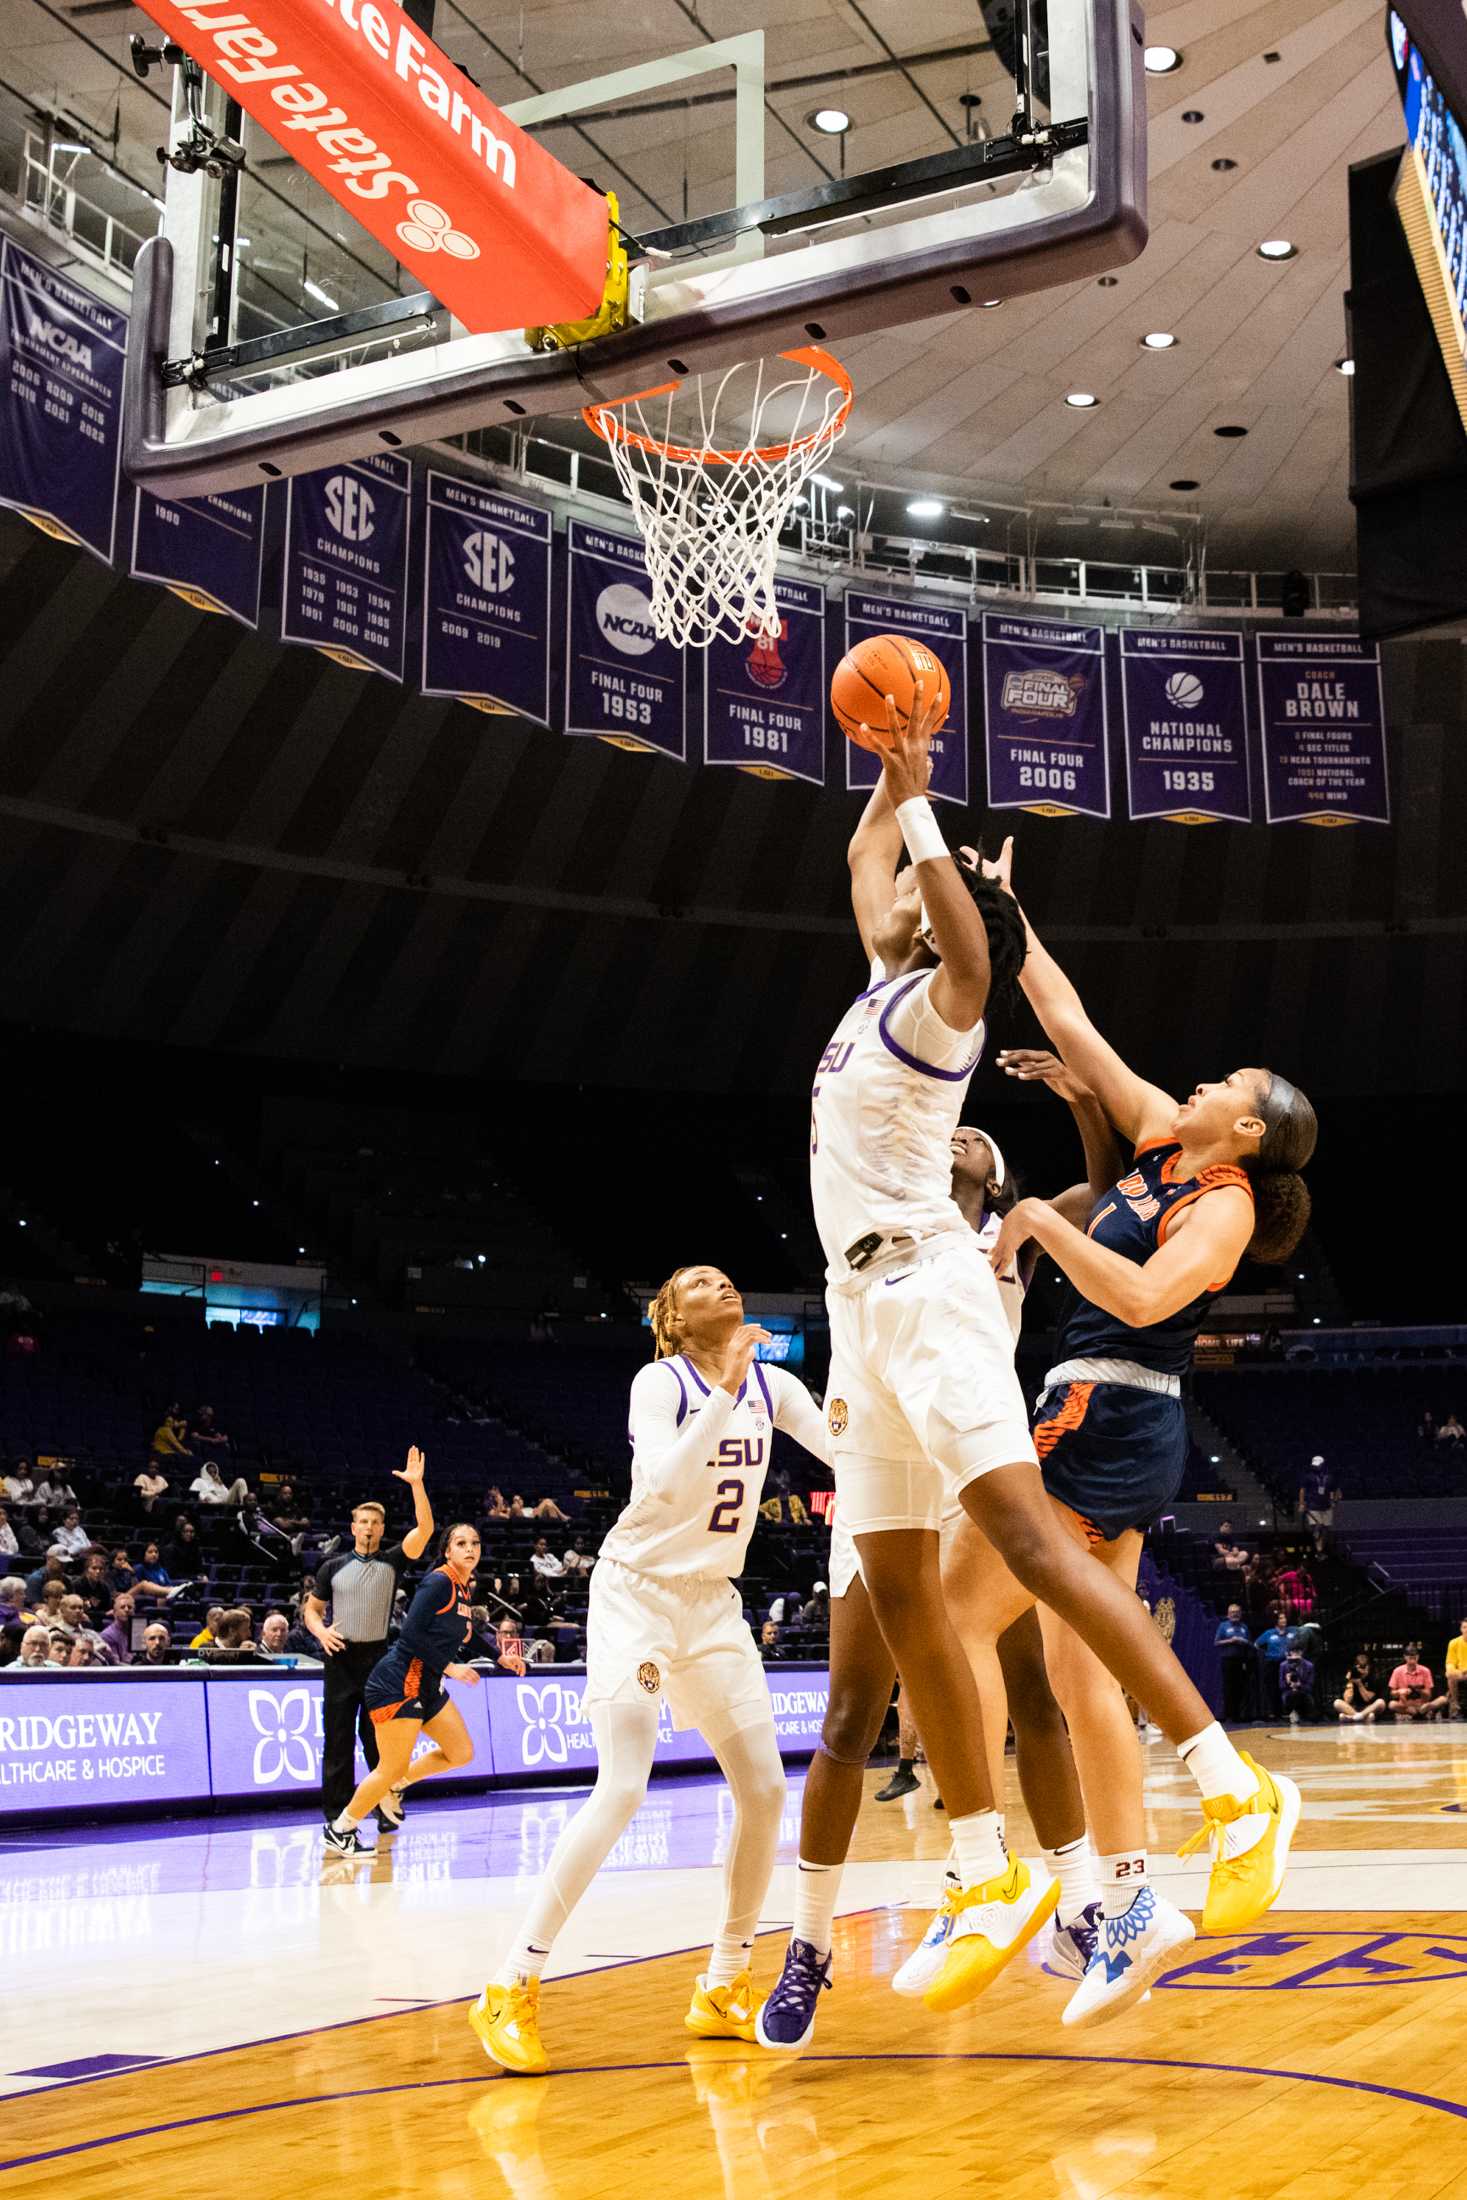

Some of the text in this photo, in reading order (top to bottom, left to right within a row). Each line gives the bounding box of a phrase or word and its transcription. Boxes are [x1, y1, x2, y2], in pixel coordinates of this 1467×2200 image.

[29, 312, 93, 372] NCAA
[324, 475, 376, 541] SEC
[445, 487, 536, 527] MEN'S BASKETBALL
[316, 537, 380, 574] CHAMPIONS
[463, 531, 516, 593] SEC
[456, 593, 521, 622] CHAMPIONS
[894, 609, 950, 628] BASKETBALL
[332, 617, 359, 636] 2000
[603, 612, 657, 642] NCAA
[1137, 637, 1227, 652] MEN'S BASKETBALL
[1306, 642, 1363, 654] BASKETBALL
[592, 670, 663, 703] FINAL FOUR
[1007, 688, 1069, 708] FOUR
[1023, 681, 1069, 695] FINAL
[1296, 682, 1346, 701] DALE
[602, 692, 652, 725] 1953
[729, 703, 802, 731] FINAL FOUR
[1285, 699, 1360, 718] BROWN
[743, 724, 788, 753] 1981
[1149, 721, 1223, 738] NATIONAL
[1142, 735, 1233, 754] CHAMPIONS
[1010, 748, 1084, 768] FINAL FOUR
[1019, 766, 1076, 791] 2006
[1162, 769, 1215, 792] 1935
[707, 1479, 745, 1534] 2
[82, 1758, 95, 1781] &
[98, 1754, 166, 1779] HOSPICE
[1115, 1858, 1145, 1879] 23
